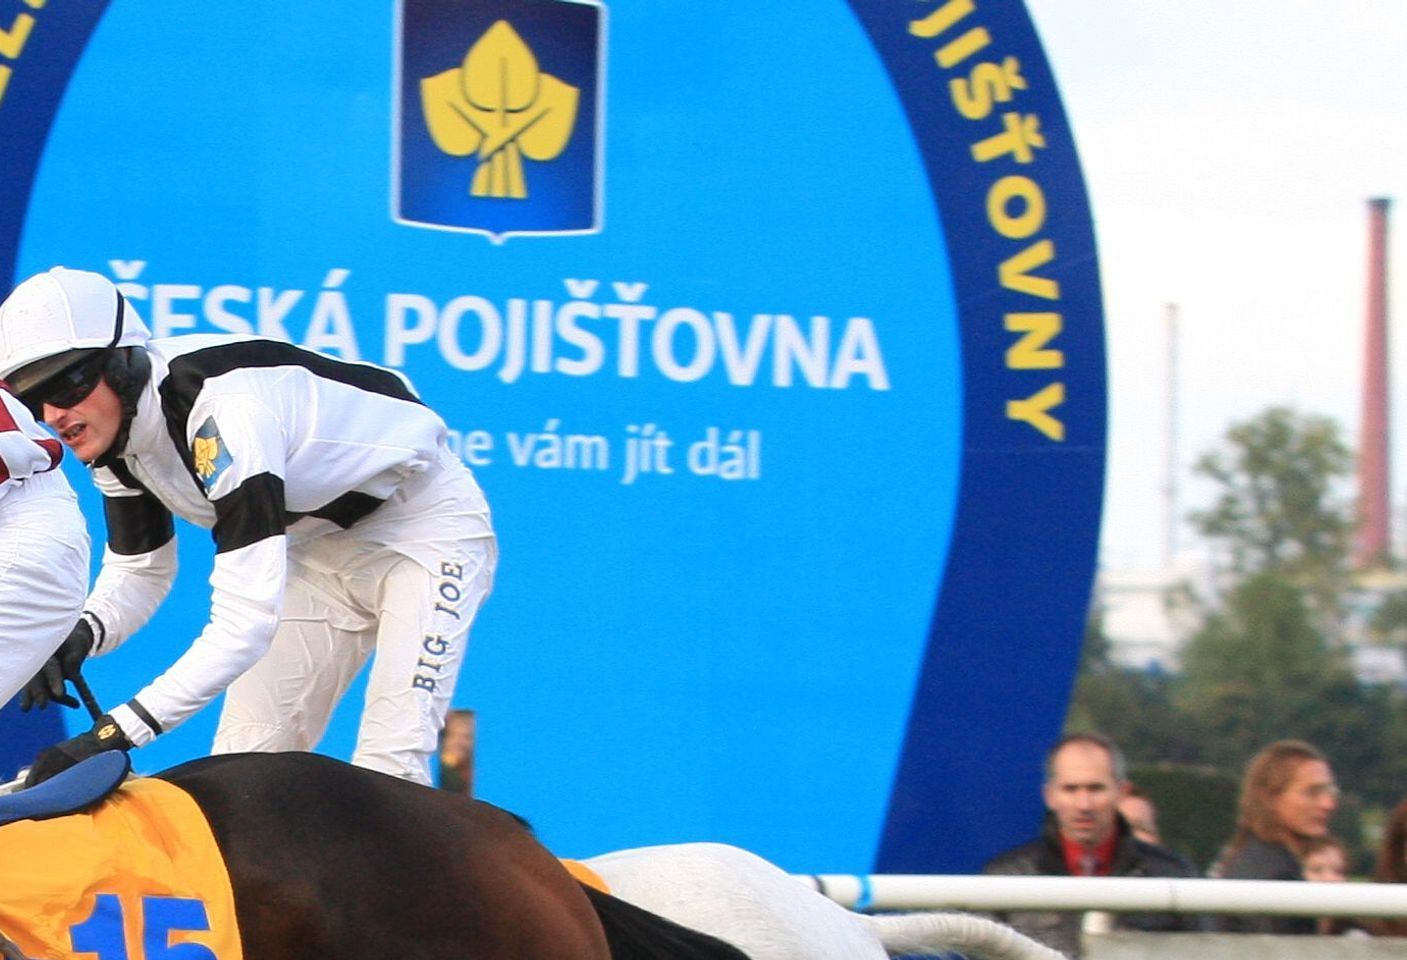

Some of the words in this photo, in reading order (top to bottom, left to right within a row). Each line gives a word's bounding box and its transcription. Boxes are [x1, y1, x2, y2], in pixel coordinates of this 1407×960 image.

[384, 278, 891, 392] POJIŠŤOVNA
[506, 418, 610, 471] vám
[619, 422, 674, 486] jít
[687, 426, 762, 481] dál
[412, 634, 449, 693] BIG
[434, 561, 463, 621] JOE
